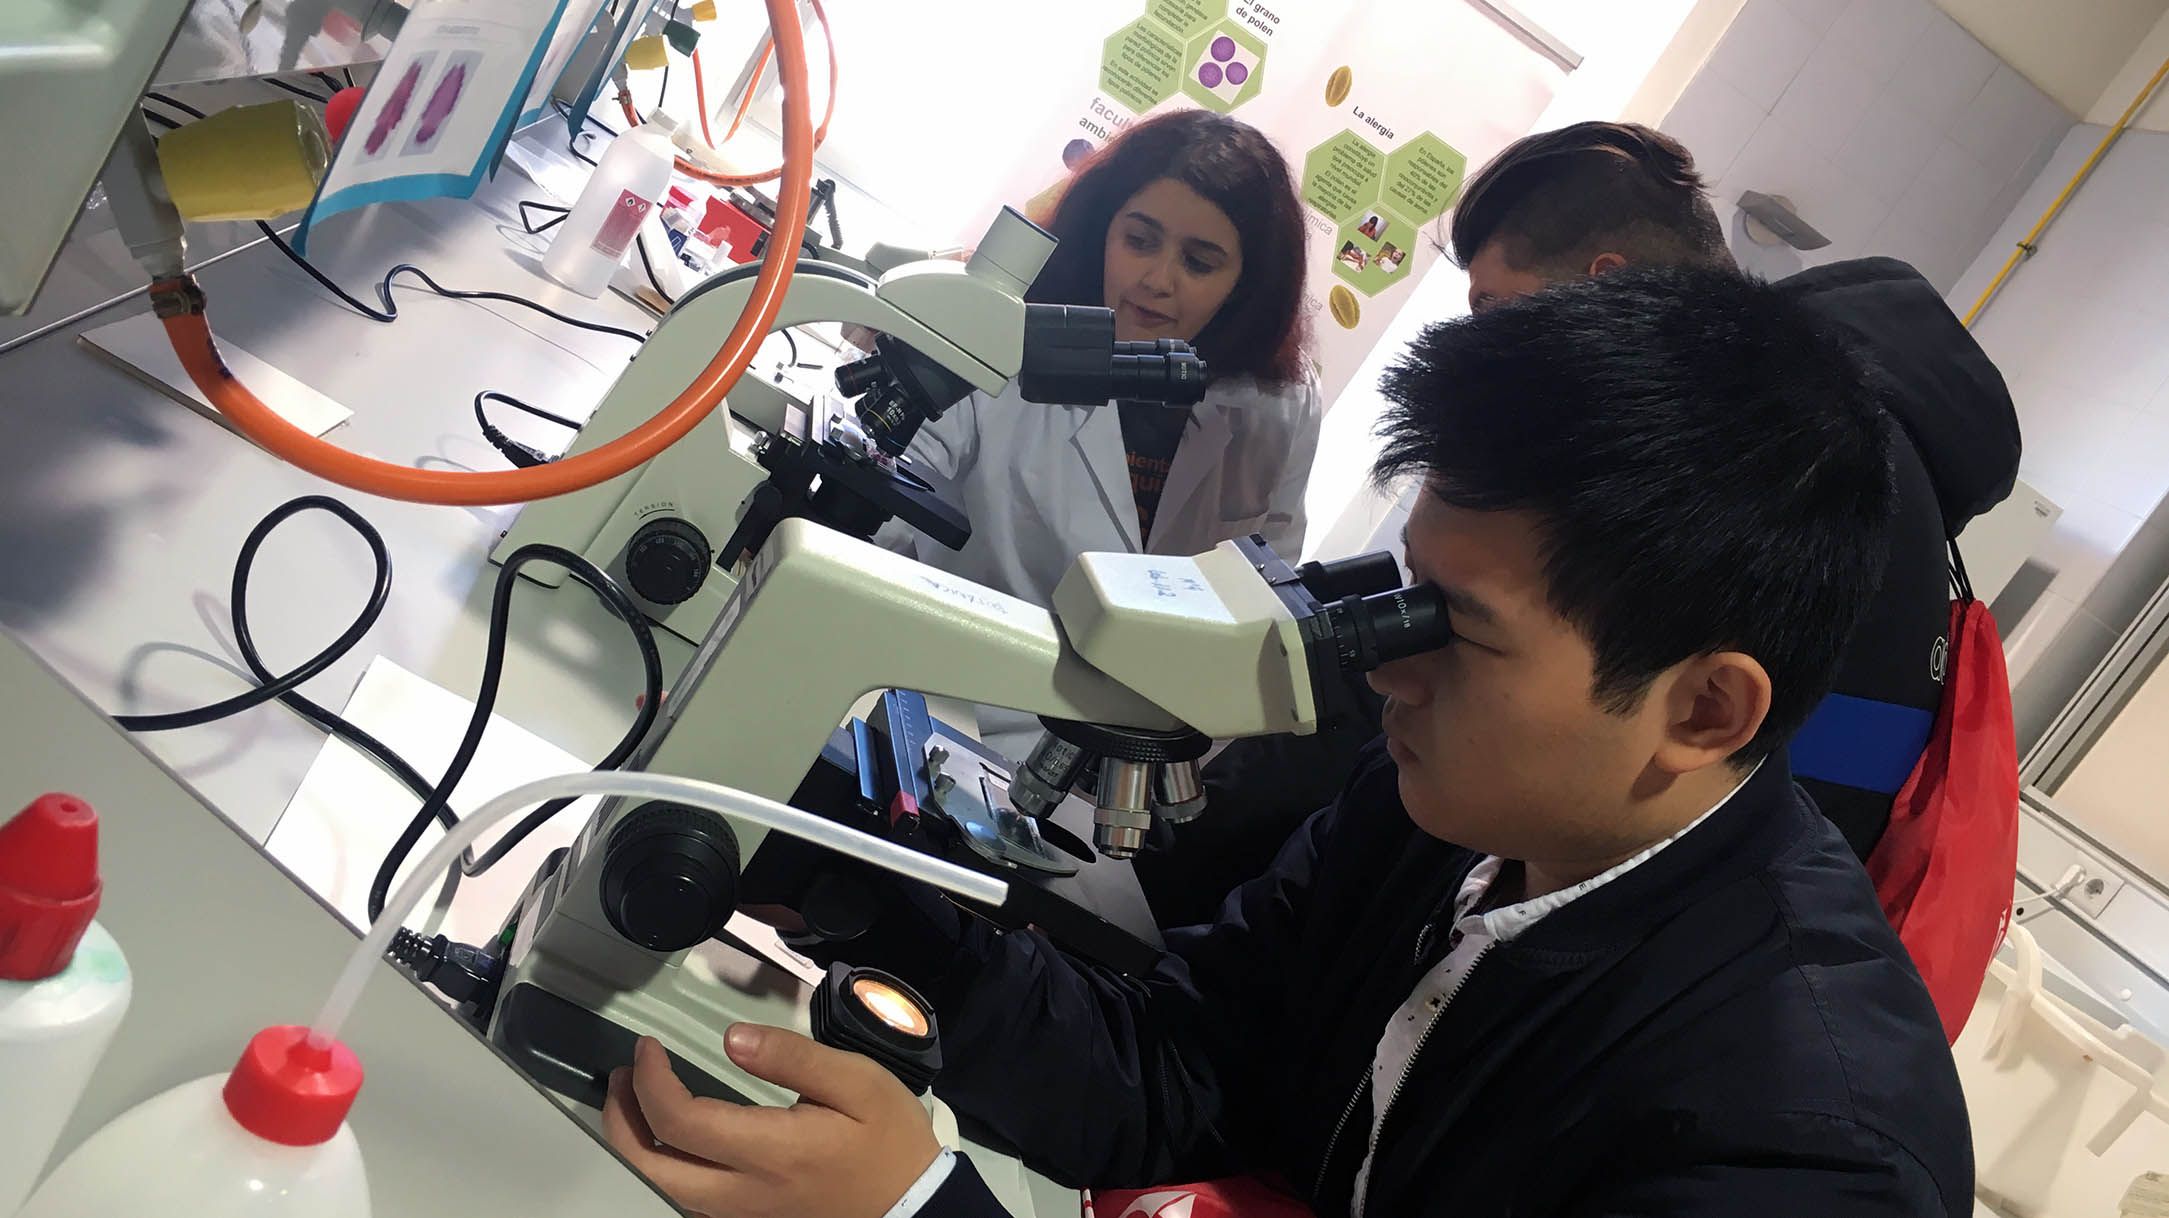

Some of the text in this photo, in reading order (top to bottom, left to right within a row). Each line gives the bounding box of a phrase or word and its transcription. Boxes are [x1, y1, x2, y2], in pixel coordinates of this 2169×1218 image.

[1235, 7, 1273, 36] de polen
[1253, 2, 1280, 24] grano
[1353, 105, 1395, 140] La alergia
[634, 501, 674, 516] TENSION
